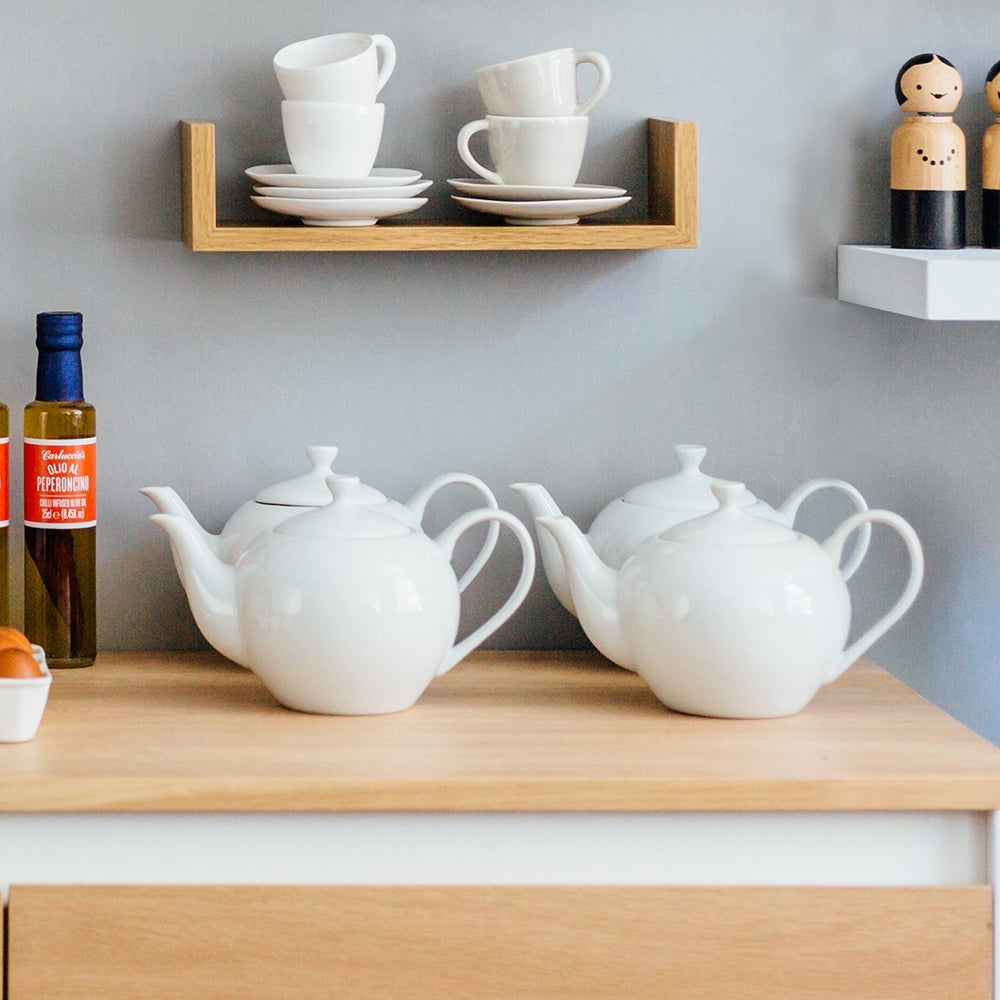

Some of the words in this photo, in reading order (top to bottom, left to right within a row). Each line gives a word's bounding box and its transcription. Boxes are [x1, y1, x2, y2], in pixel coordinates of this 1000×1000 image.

[41, 449, 85, 461] Carluccio's
[47, 462, 67, 475] OLIO
[68, 463, 79, 474] AL
[37, 476, 89, 492] PEPERONCINO
